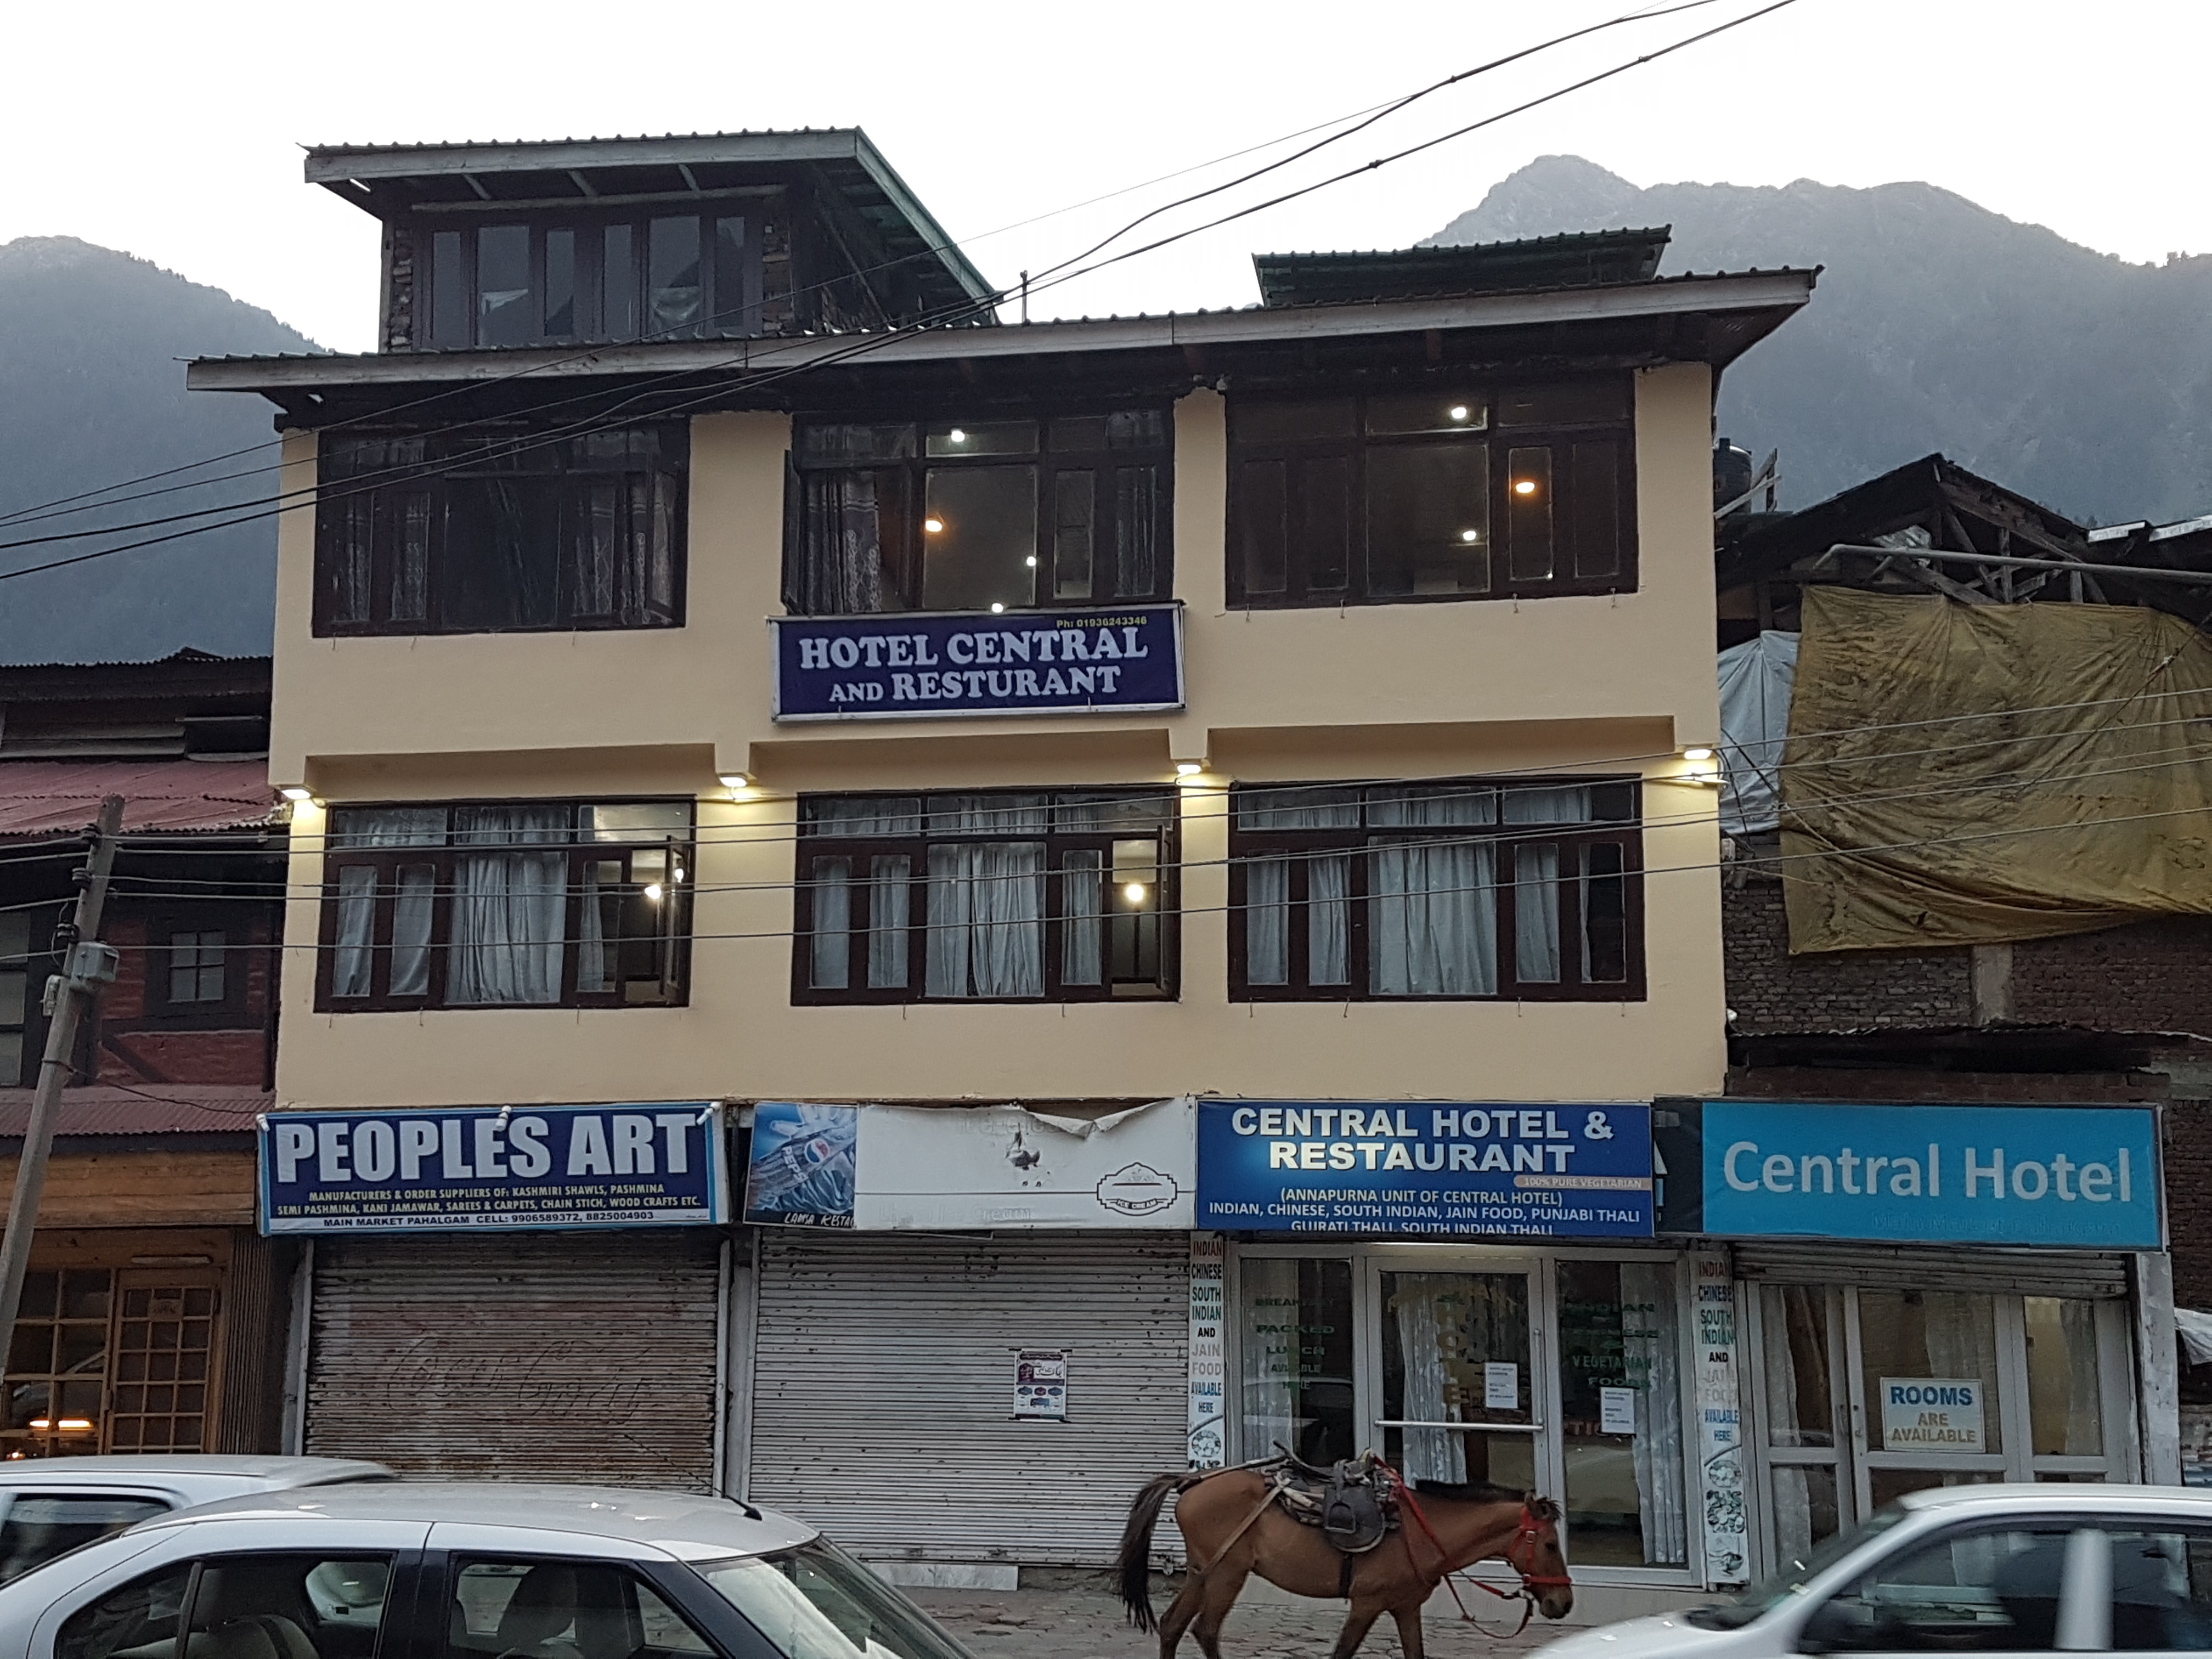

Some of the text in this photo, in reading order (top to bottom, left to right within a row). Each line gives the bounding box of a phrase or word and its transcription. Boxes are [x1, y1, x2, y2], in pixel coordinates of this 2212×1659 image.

[799, 627, 1148, 669] HOTEL CENTRAL
[829, 665, 1121, 702] AND RESTURANT
[1232, 1108, 1614, 1141] CENTRAL HOTEL &
[275, 1114, 697, 1183] PEOPLES ART
[1269, 1141, 1576, 1173] RESTAURANT
[1724, 1141, 2132, 1201] Central Hotel
[1525, 1177, 1642, 1188] 100% PURE VEGETARIAN
[309, 1184, 665, 1201] MANUFACTURERS & ORDER SUPPLIERS OF: KASHMIRI SHAWLS, PASHMINA
[1281, 1187, 1562, 1207] (ANNAPURNA UNIT OF CENTRAL HOTEL)
[278, 1196, 701, 1215] SEMI PASHMINA, KANI JAMAWAR, SAREES & CARPETS, CHAIN STICH, WOOD CRAFTS ETC.
[1210, 1202, 1640, 1222] INDIAN, CHINESE, SOUTH INDIAN, JAIN FOOD, PUNJABI THALI
[324, 1218, 353, 1227] MAIN
[357, 1217, 403, 1226] MARKET
[408, 1216, 470, 1225] PAHALGAM
[476, 1215, 509, 1223] CELL:
[586, 1211, 654, 1221] 8825004903
[1401, 1222, 1450, 1234] SOUTH
[1455, 1223, 1507, 1235] INDIAN
[1511, 1224, 1553, 1235] THALI
[1193, 1241, 1222, 1256] INDIAN
[1192, 1263, 1222, 1279] CHINESE
[1192, 1286, 1221, 1302] SOUTH
[1192, 1305, 1221, 1321] INDIAN
[1701, 1309, 1733, 1326] SOUTH
[1198, 1327, 1216, 1338] AND
[1192, 1344, 1221, 1357] JAIN
[1267, 1346, 1325, 1356] LUCH
[1709, 1352, 1729, 1363] AND
[1192, 1362, 1222, 1376] FOOD
[1192, 1381, 1222, 1396] AVAILABLE
[1891, 1386, 1973, 1406] ROOMS
[1198, 1401, 1214, 1413] HERE
[1705, 1409, 1739, 1424] AVAILABLE
[1918, 1412, 1949, 1426] ARE
[1714, 1430, 1732, 1442] HERE
[1891, 1427, 1977, 1443] AVAILABLE
